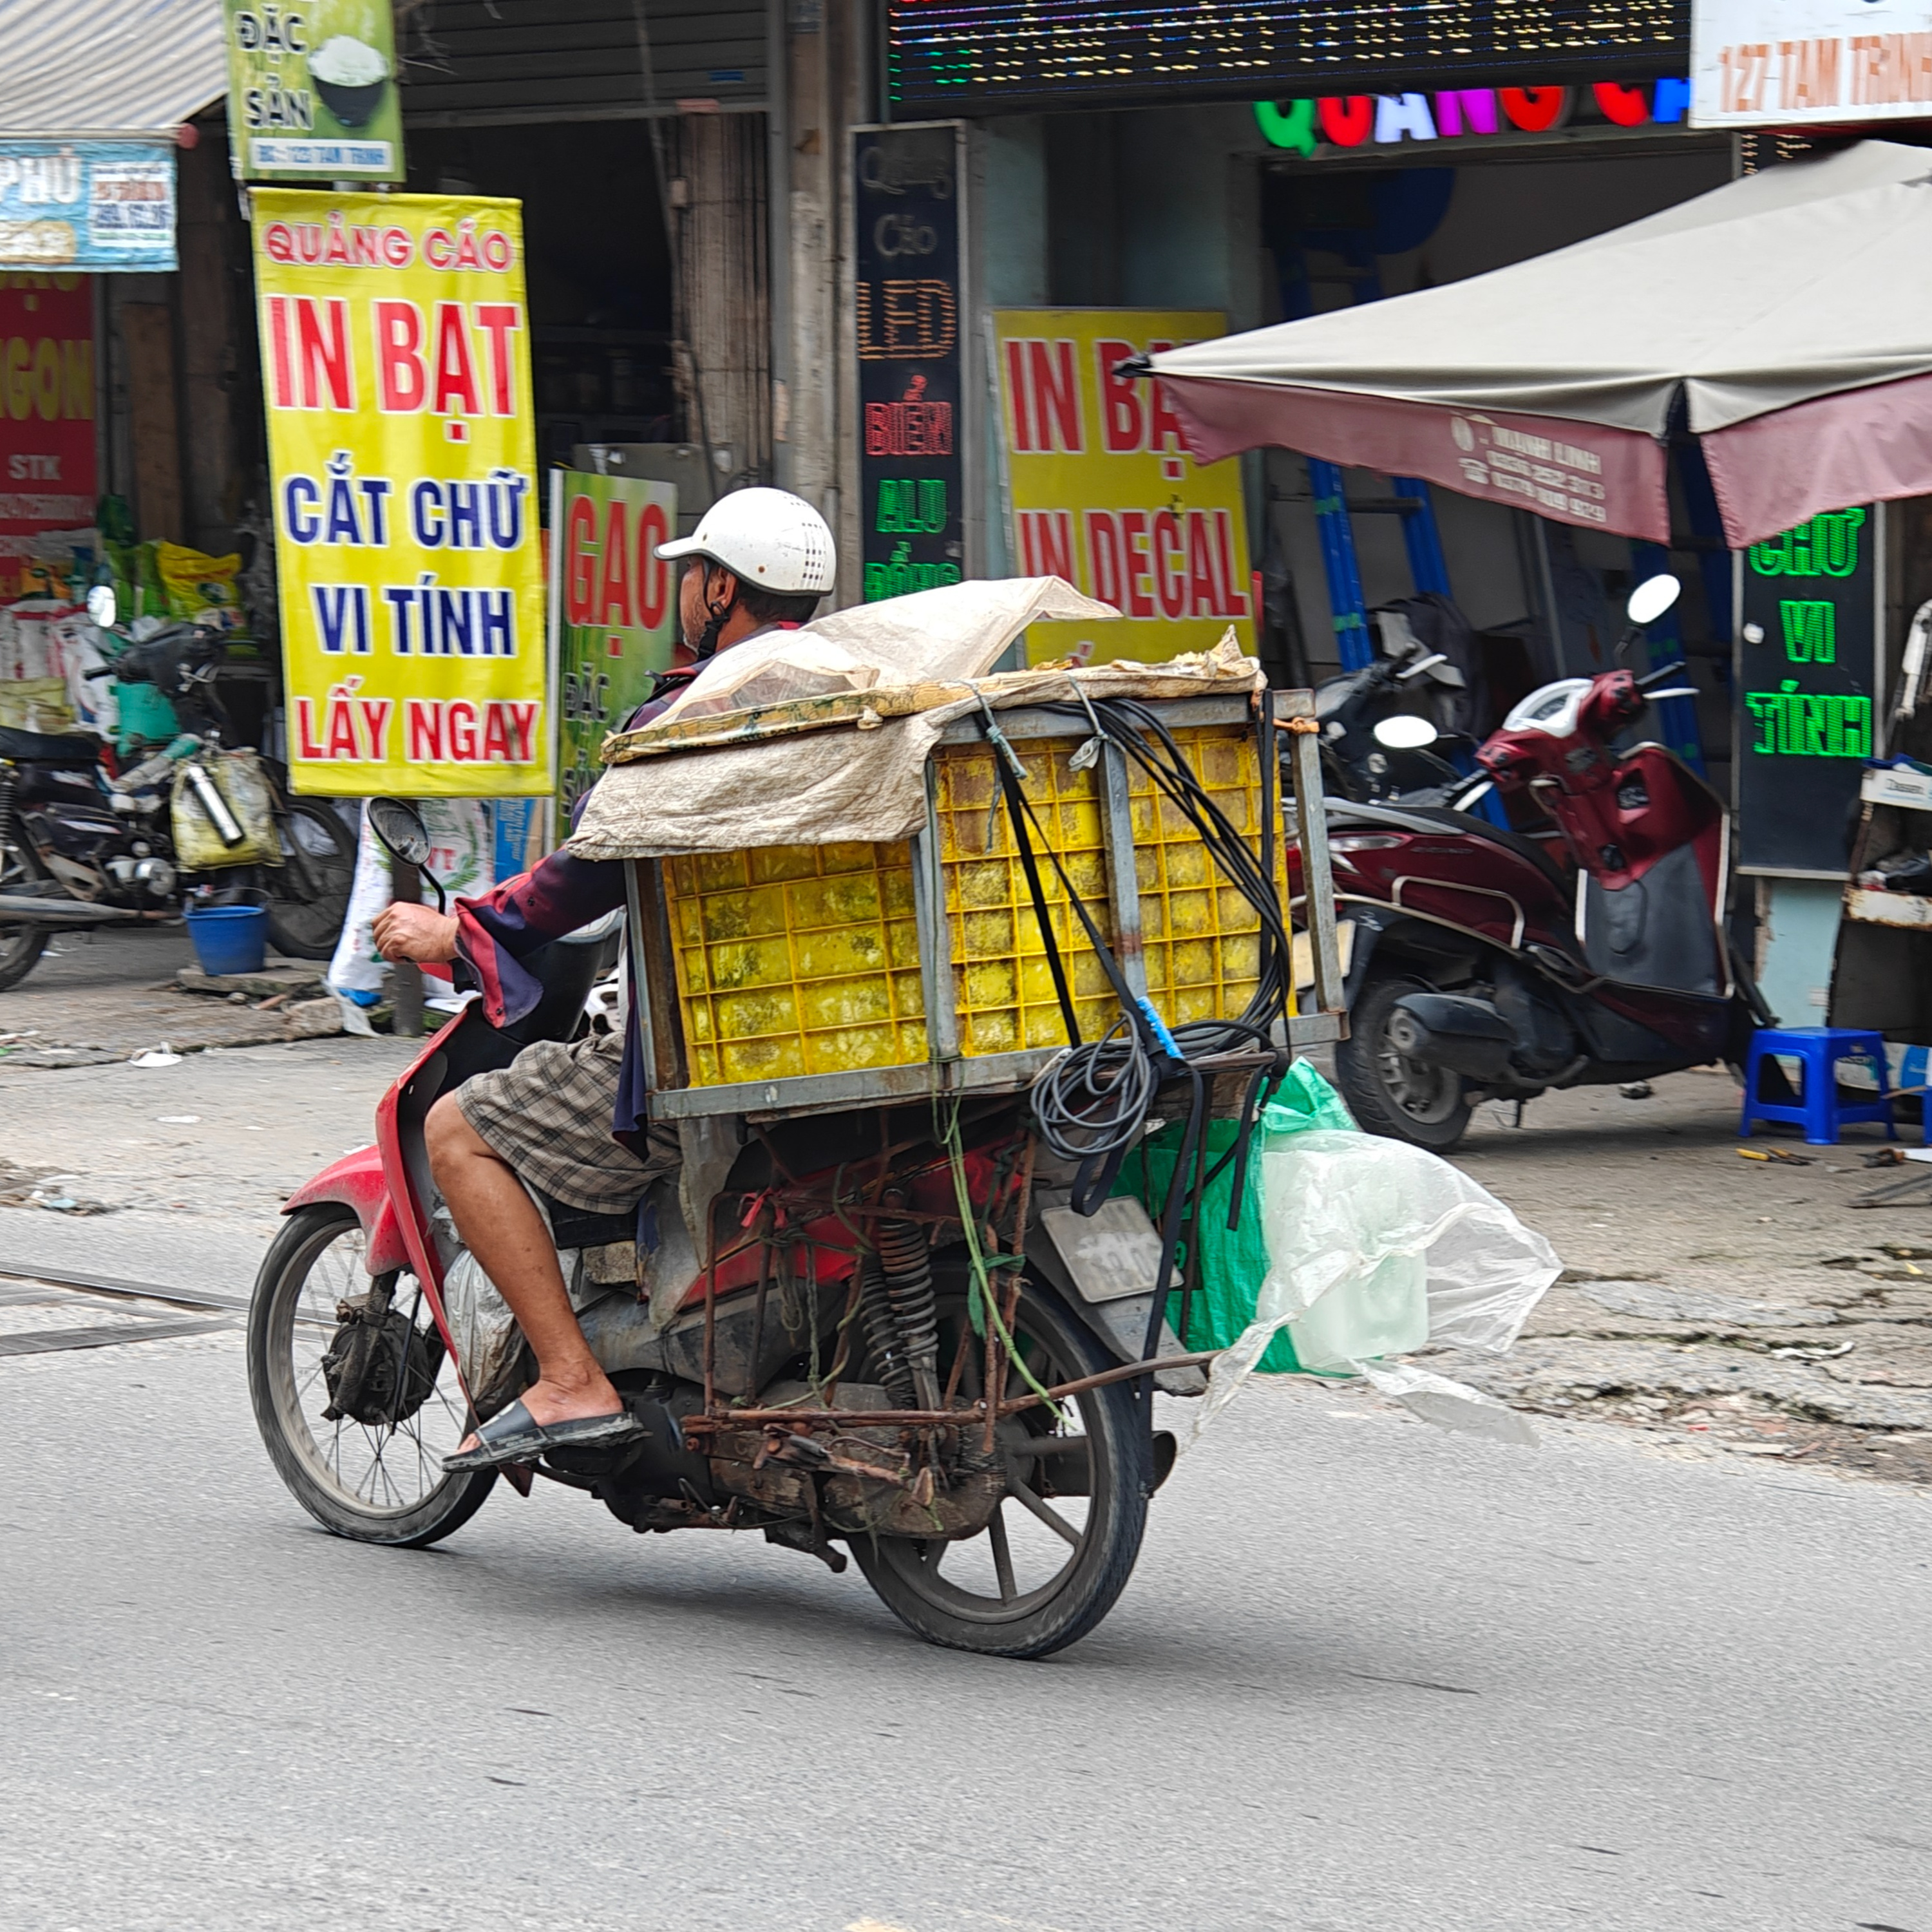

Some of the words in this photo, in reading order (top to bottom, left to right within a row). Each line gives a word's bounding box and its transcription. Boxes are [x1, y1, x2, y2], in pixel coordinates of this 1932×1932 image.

[236, 4, 307, 64] ĐẶC
[1718, 43, 1770, 112] 127
[1777, 38, 1842, 109] TAM
[243, 73, 314, 130] SẢN
[265, 211, 413, 268] QUẢNG
[424, 219, 515, 272] CÁO
[857, 279, 956, 360] LED
[265, 296, 355, 411] IN
[372, 299, 521, 443] BẠT
[1001, 338, 1085, 455] IN
[1095, 338, 1215, 480] BẠ
[283, 450, 392, 547] CẮT
[410, 467, 530, 551] CHỮ
[875, 480, 947, 534] ALU
[565, 494, 670, 658] GẠO
[1083, 507, 1251, 622] DECAL
[310, 583, 374, 655] VI
[381, 571, 518, 658] TÍNH
[1779, 600, 1835, 663] VI
[294, 674, 393, 763] LẤY
[404, 699, 541, 764] NGAY
